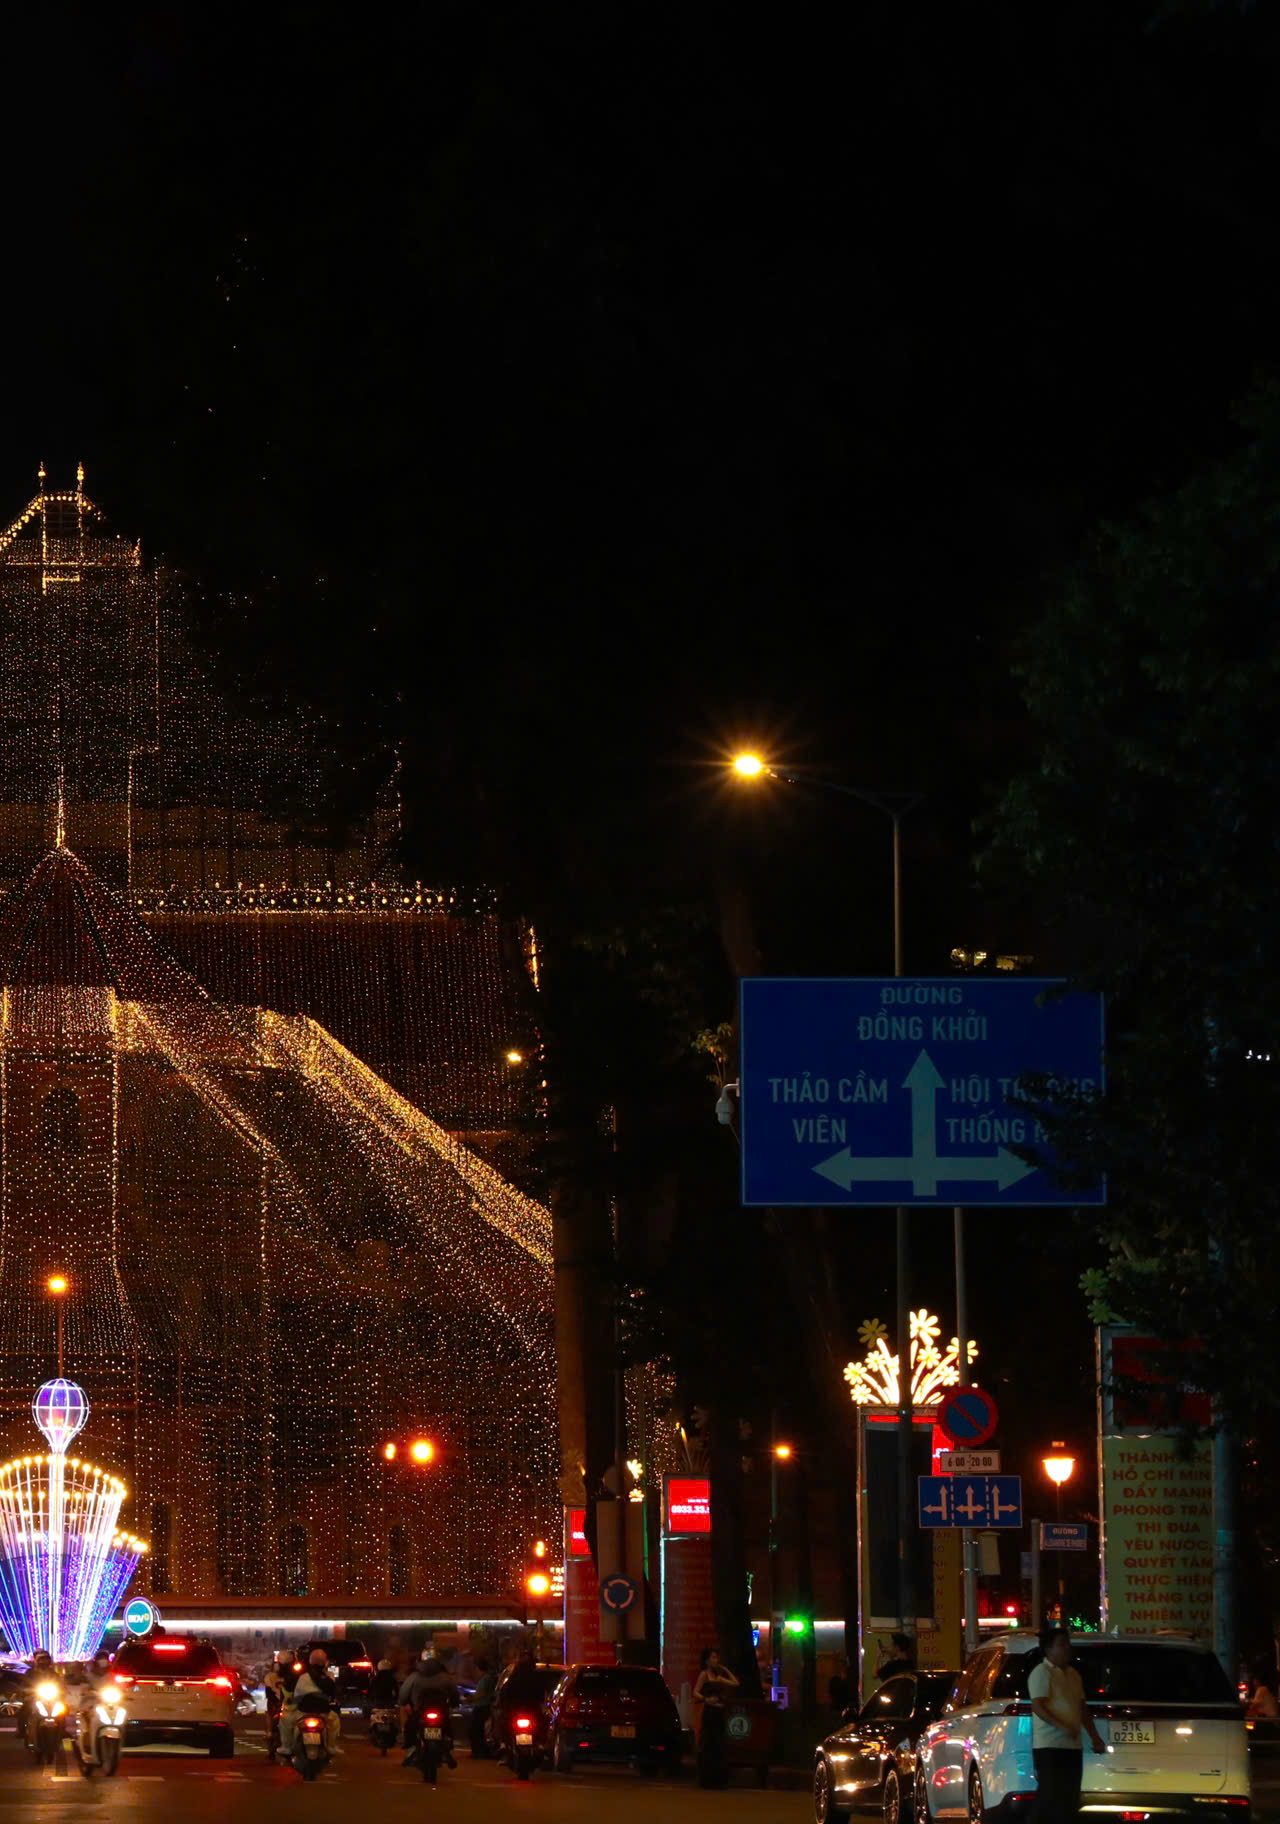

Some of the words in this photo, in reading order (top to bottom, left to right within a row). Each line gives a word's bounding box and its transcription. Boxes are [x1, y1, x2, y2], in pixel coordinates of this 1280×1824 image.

[879, 983, 964, 1006] ĐƯỜNG
[856, 1007, 924, 1042] ĐỒNG
[931, 1008, 988, 1042] KHỞI
[768, 1070, 830, 1104] THẢO
[837, 1068, 889, 1104] CẦM
[951, 1073, 991, 1109] HỘI
[792, 1112, 847, 1144] VIÊN
[944, 1108, 1025, 1144] THỐNG
[1113, 1465, 1138, 1481] HỒ
[1144, 1467, 1173, 1481] CHÍ
[1180, 1470, 1211, 1481] MIN
[1123, 1481, 1157, 1498] ĐẨY
[1113, 1504, 1176, 1515] PHONG
[1181, 1503, 1212, 1515] TRÀ
[1136, 1522, 1161, 1533] THI
[1167, 1522, 1200, 1533] ĐUA
[1124, 1537, 1153, 1550] YÊU
[1124, 1554, 1176, 1568] QUYẾT
[1126, 1574, 1172, 1586] THỰC
[1125, 1585, 1184, 1603] THẮNG
[1130, 1608, 1183, 1622] NHIỆM
[1121, 1721, 1142, 1732] 51K
[1113, 1732, 1151, 1743] 023.84
